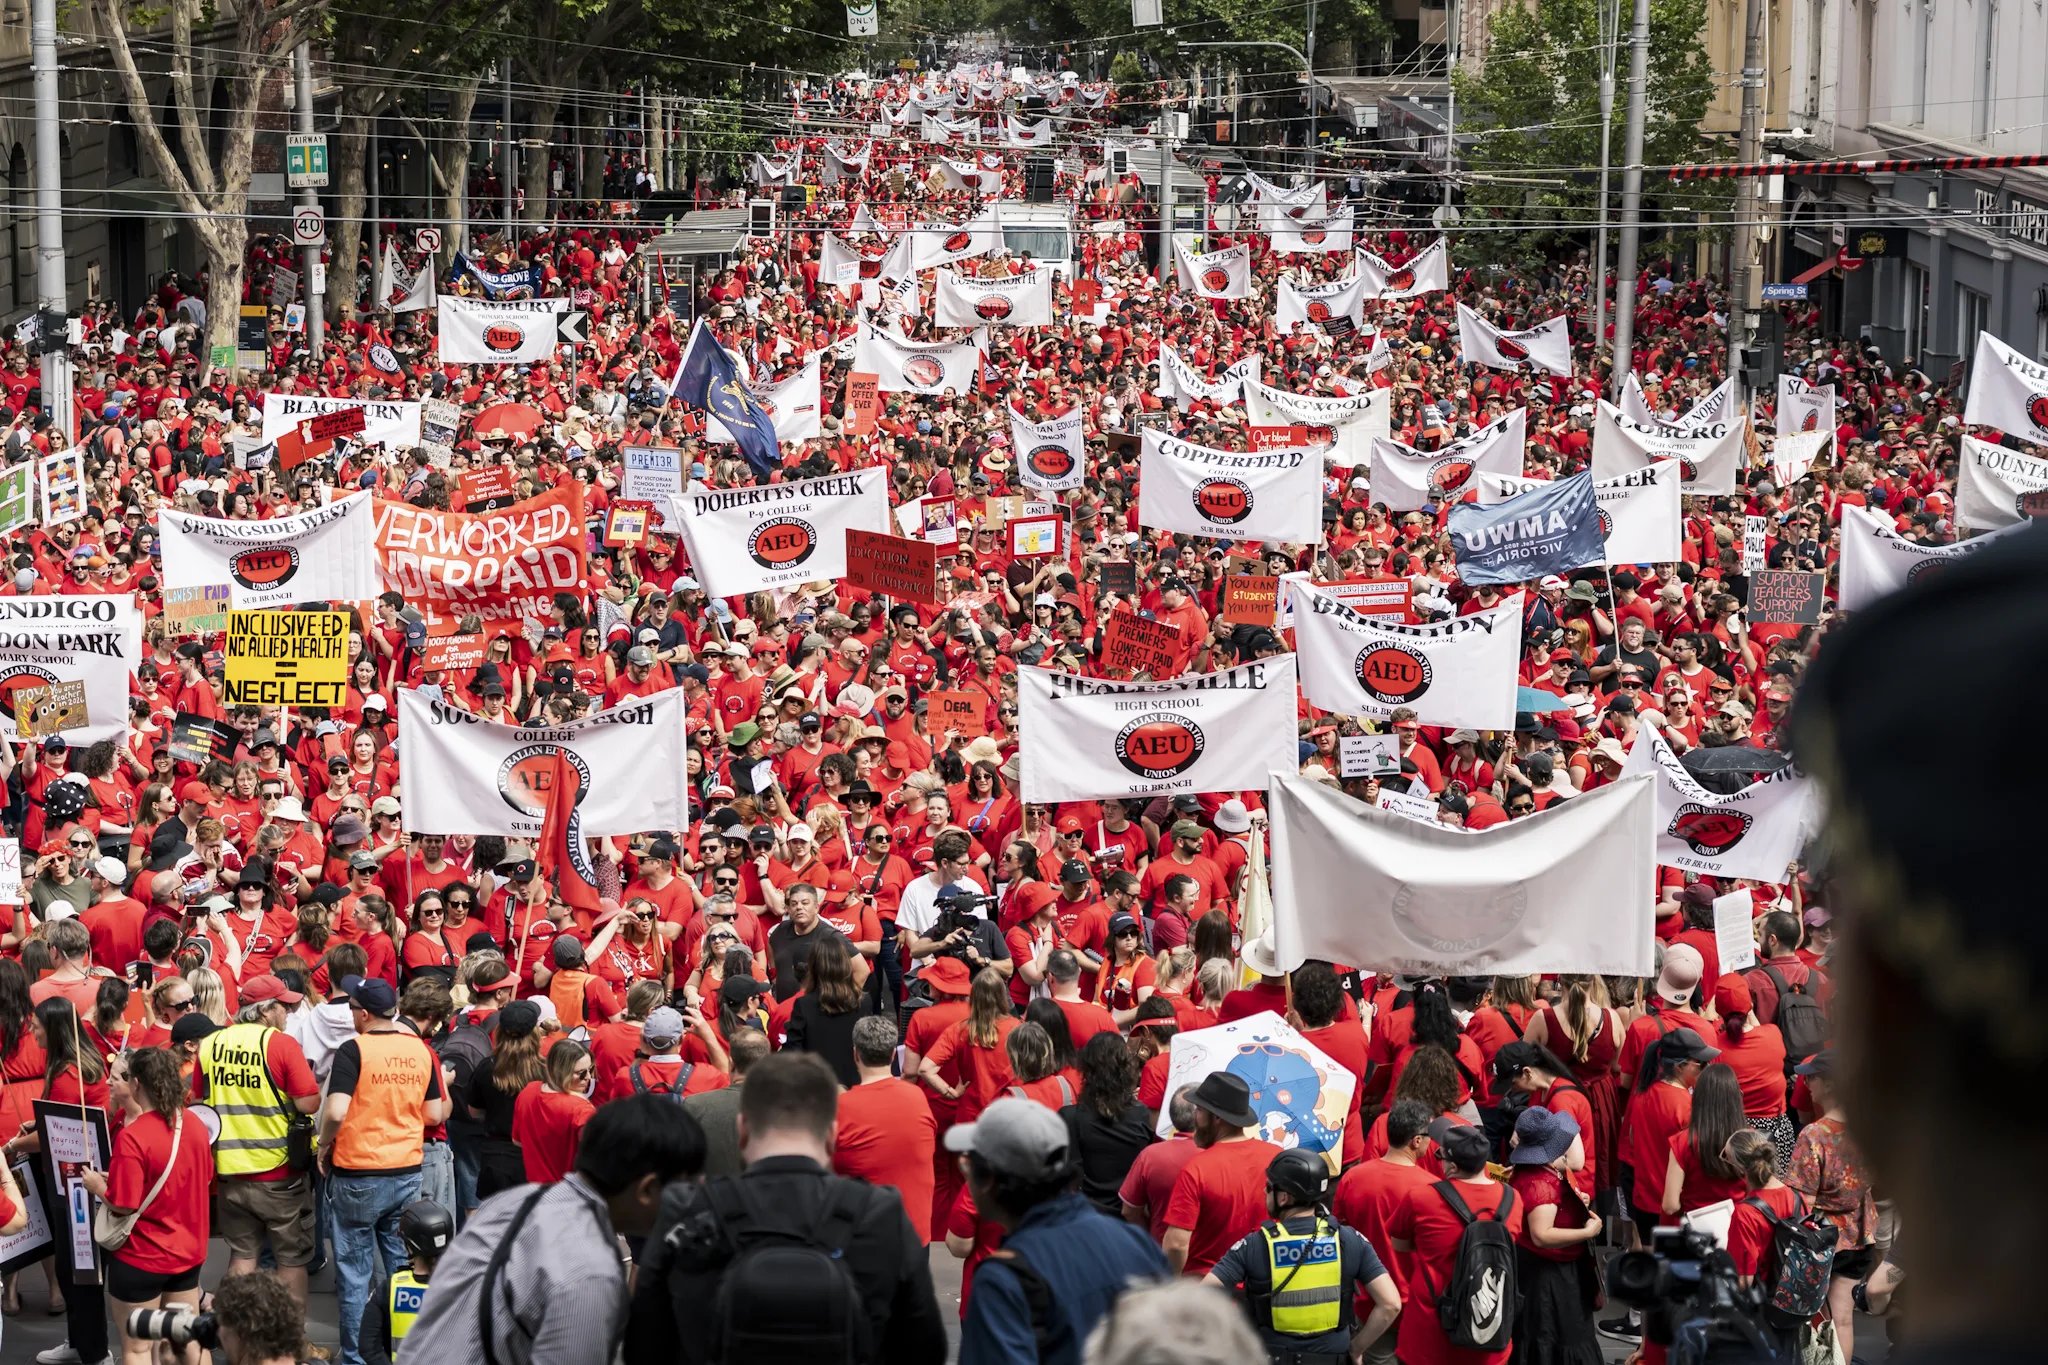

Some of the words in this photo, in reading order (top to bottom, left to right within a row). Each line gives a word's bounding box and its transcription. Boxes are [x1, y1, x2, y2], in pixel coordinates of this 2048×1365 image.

[849, 16, 875, 25] ONLY
[289, 136, 324, 145] FAIRWAY
[307, 178, 328, 186] TIMES
[297, 219, 321, 232] 40
[1220, 248, 1245, 261] ERIN
[501, 270, 531, 284] GROVE
[997, 272, 1037, 286] NORTH
[1767, 286, 1795, 297] Spring
[1796, 286, 1807, 295] St
[452, 300, 557, 314] NEWBURY
[490, 331, 519, 342] AEU
[373, 349, 396, 367] AEU
[852, 381, 877, 390] WORST
[851, 391, 874, 400] OFFER
[1259, 387, 1372, 413] RINGWOOD
[854, 400, 872, 409] EVER
[1693, 390, 1726, 425] NORTH
[1253, 430, 1272, 443] Our
[1272, 431, 1292, 442] blood
[631, 453, 673, 468] PREMI3R
[1158, 439, 1304, 469] COPPERFIELD
[465, 471, 486, 481] Lowest
[487, 468, 504, 477] funded
[1208, 468, 1248, 477] COLLEGE
[477, 476, 497, 485] schools
[1046, 480, 1070, 488] North
[475, 483, 502, 494] Underpaid
[1193, 476, 1225, 506] AUSTRALIAN
[1225, 476, 1254, 508] EDUCATION
[467, 494, 477, 502] ES
[477, 492, 487, 500] and
[487, 489, 510, 499] principals
[694, 485, 795, 517] DOHERTYS
[800, 475, 864, 497] CREEK
[1202, 491, 1242, 508] AEU
[749, 510, 764, 519] P-9
[767, 503, 813, 517] COLLEGE
[182, 517, 297, 538] SPRINGSIDE
[301, 501, 351, 529] WEST
[1211, 516, 1234, 525] UNION
[1747, 518, 1766, 533] FUND
[213, 538, 274, 547] SECONDARY
[275, 528, 321, 545] COLLEGE
[749, 518, 781, 557] AUSTRALIAN
[781, 517, 817, 546] EDUCATION
[1200, 526, 1214, 534] SUB
[1215, 528, 1245, 536] BRANCH
[759, 532, 806, 553] AEU
[1745, 537, 1765, 552] PUBLIC
[230, 546, 267, 576] AUSTRALIAN
[849, 547, 910, 565] EDUCATION
[241, 553, 286, 573] AEU
[771, 559, 798, 570] UNION
[761, 575, 778, 584] SUB
[778, 570, 811, 581] BRANCH
[1230, 577, 1250, 590] YOU
[1253, 579, 1274, 590] CAN
[1757, 572, 1814, 588] SUPPORT
[252, 580, 279, 590] UNION
[1360, 582, 1408, 592] INTENTION:
[204, 585, 230, 600] PAID
[242, 597, 258, 605] SUB
[259, 592, 293, 603] BRANCH
[1232, 590, 1276, 601] STUDENTS
[1365, 595, 1404, 605] teachers.
[1753, 597, 1807, 612] SUPPORT
[217, 602, 227, 613] in
[1228, 603, 1250, 615] YOU
[1251, 604, 1270, 614] PUT
[1765, 612, 1795, 622] KIDS!
[168, 621, 182, 634] the
[231, 614, 343, 637] INCLUSIVE-ED
[1117, 624, 1168, 650] PREMIERS
[1159, 624, 1180, 641] PAID
[58, 633, 124, 659] PARK
[228, 636, 246, 656] NO
[249, 637, 289, 658] ALLIED
[292, 637, 342, 659] HEALTH
[428, 637, 447, 647] 100%
[447, 635, 475, 645] FUNDING
[445, 645, 460, 654] FOR
[1110, 638, 1149, 661] LOWEST
[1153, 650, 1173, 669] PAID
[31, 655, 77, 666] SCHOOL
[431, 653, 448, 664] OUR
[449, 649, 483, 660] STUDENTS
[1356, 641, 1395, 679] AUSTRALIAN
[1395, 641, 1432, 685] EDUCATION
[445, 660, 473, 670] NOW!
[1366, 660, 1418, 683] AEU
[1050, 663, 1268, 700] HEALESVILLE
[52, 690, 81, 701] Teacher
[224, 680, 346, 704] NEGLECT
[1375, 691, 1405, 704] UNION
[68, 698, 85, 706] 2026
[944, 699, 974, 714] DEAL
[1114, 701, 1149, 711] HIGH
[1151, 698, 1204, 711] SCHOOL
[1361, 704, 1378, 714] SUB
[514, 731, 576, 742] COLLEGE
[1116, 714, 1158, 759] AUSTRALIAN
[1160, 713, 1204, 751] EDUCATION
[1130, 735, 1191, 756] AEU
[498, 745, 543, 793] AUSTRALIAN
[1144, 767, 1177, 779] UNION
[1129, 784, 1149, 793] SUB
[1151, 779, 1193, 792] BRANCH
[511, 822, 531, 831] SUB
[1702, 806, 1753, 836] EDUCATION
[1695, 844, 1720, 856] UNION
[1675, 857, 1691, 866] SUB
[1691, 859, 1722, 872] BRANCH
[213, 1043, 261, 1067] Union
[385, 1057, 417, 1069] VTHC
[213, 1066, 261, 1089] Media
[52, 1121, 63, 1131] We
[54, 1149, 82, 1158] another
[1470, 1266, 1499, 1325] NIKE
